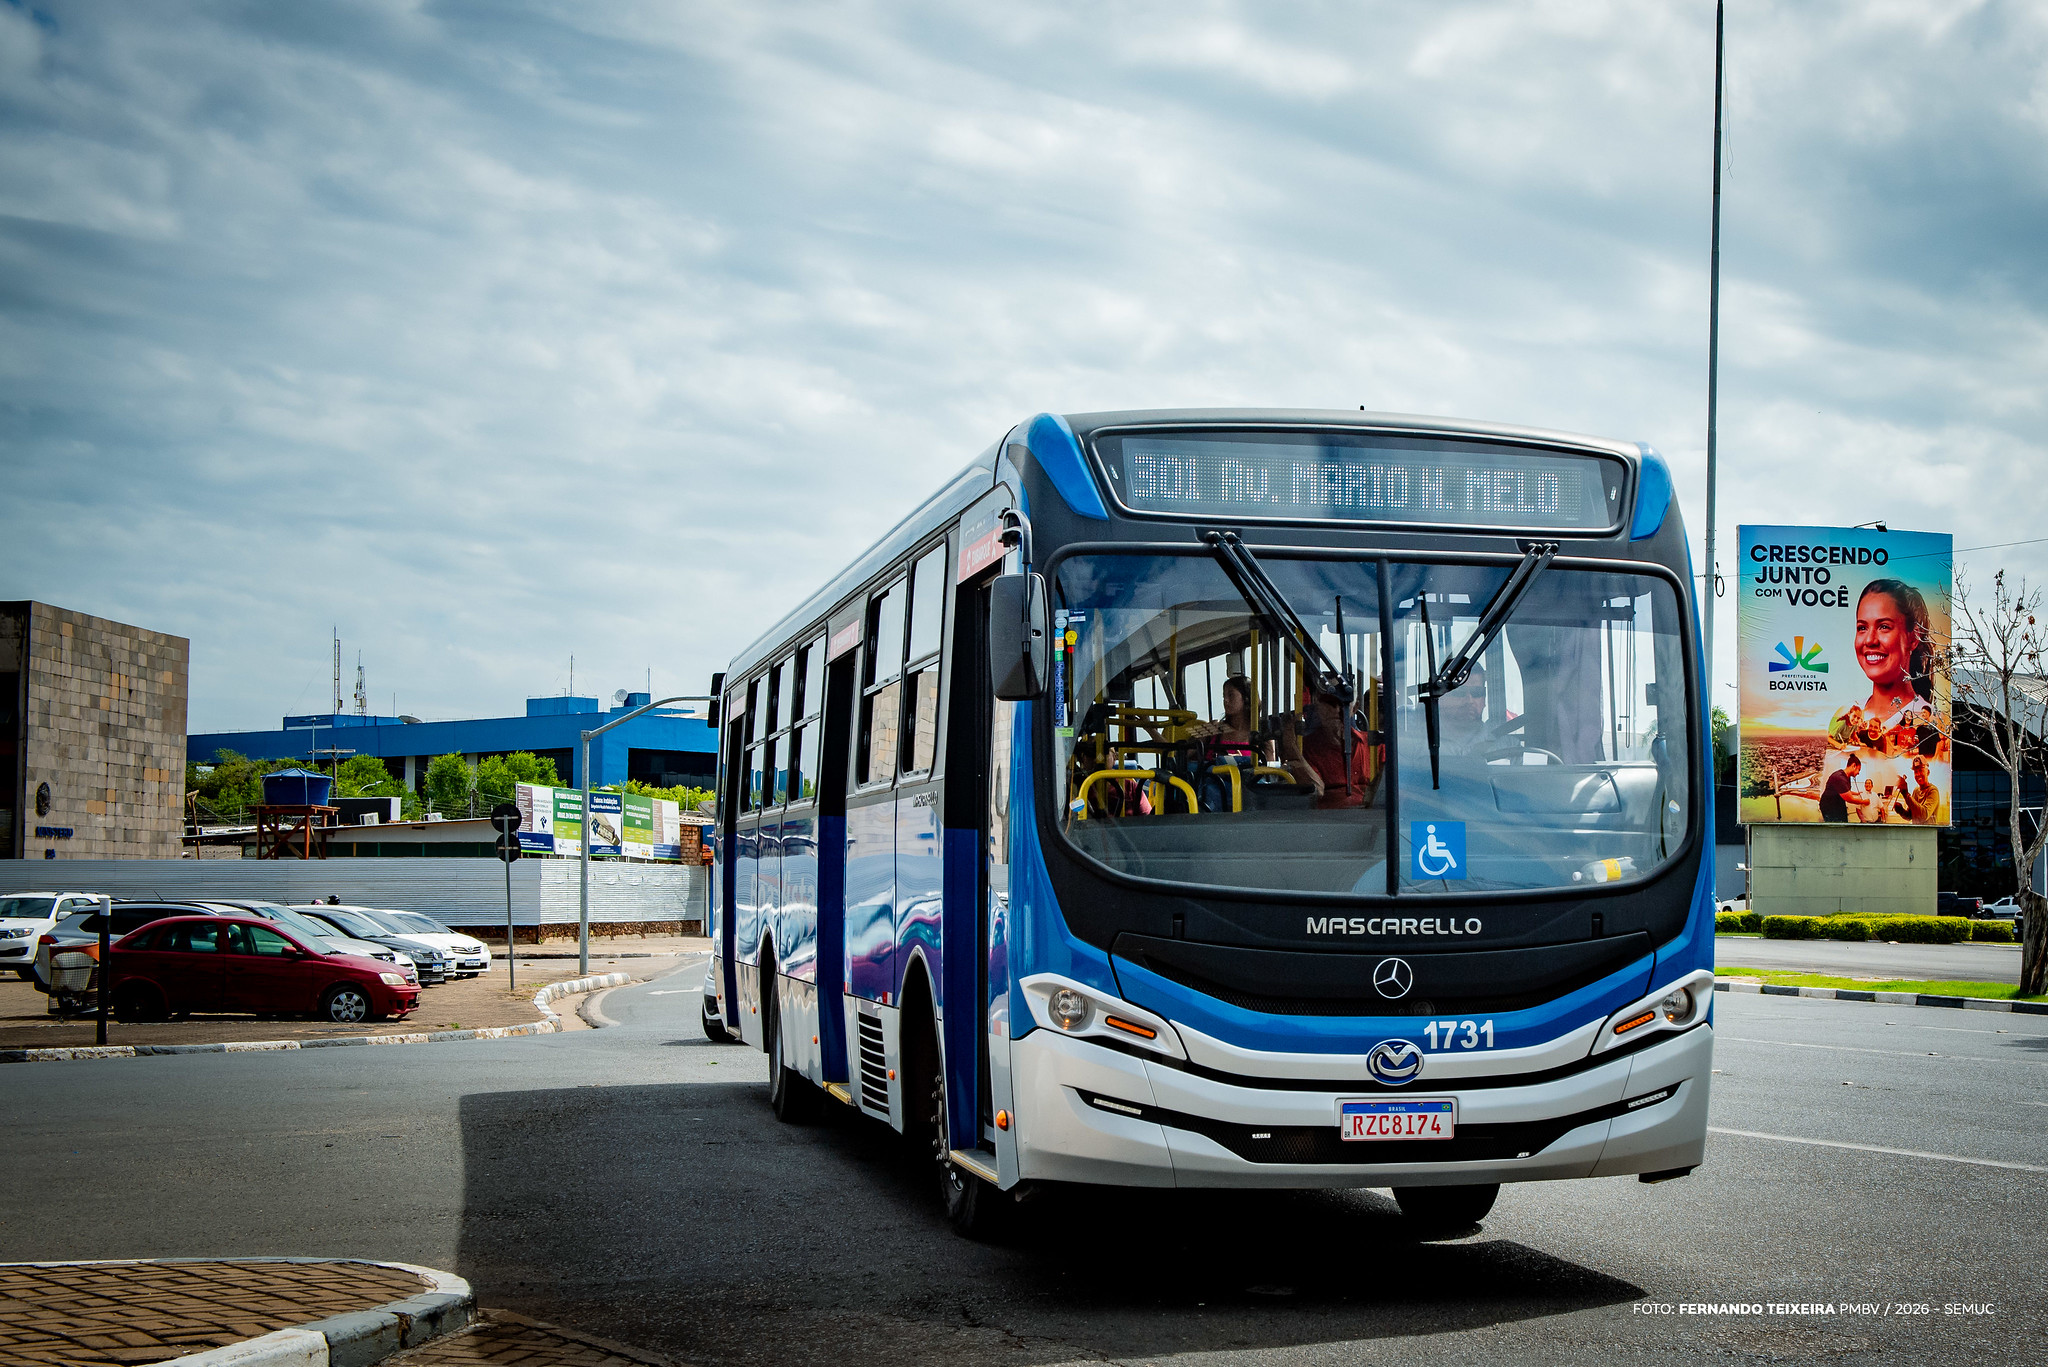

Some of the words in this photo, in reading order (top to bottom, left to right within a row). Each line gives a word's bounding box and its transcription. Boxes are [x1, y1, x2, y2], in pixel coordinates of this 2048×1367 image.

[1133, 455, 1200, 500] 301
[1291, 462, 1408, 508] MARIO
[1420, 468, 1453, 510] H.
[1465, 470, 1559, 514] MELO
[1749, 544, 1889, 566] CRESCENDO
[1754, 566, 1831, 585] JUNTO
[1755, 588, 1782, 598] COM
[1785, 585, 1849, 608] VOCÊ
[1769, 680, 1795, 691] BOA
[1795, 681, 1828, 692] VISTA
[1306, 916, 1482, 935] MASCARELLO
[1423, 1020, 1494, 1050] 1731
[1352, 1114, 1442, 1136] RZC8I74
